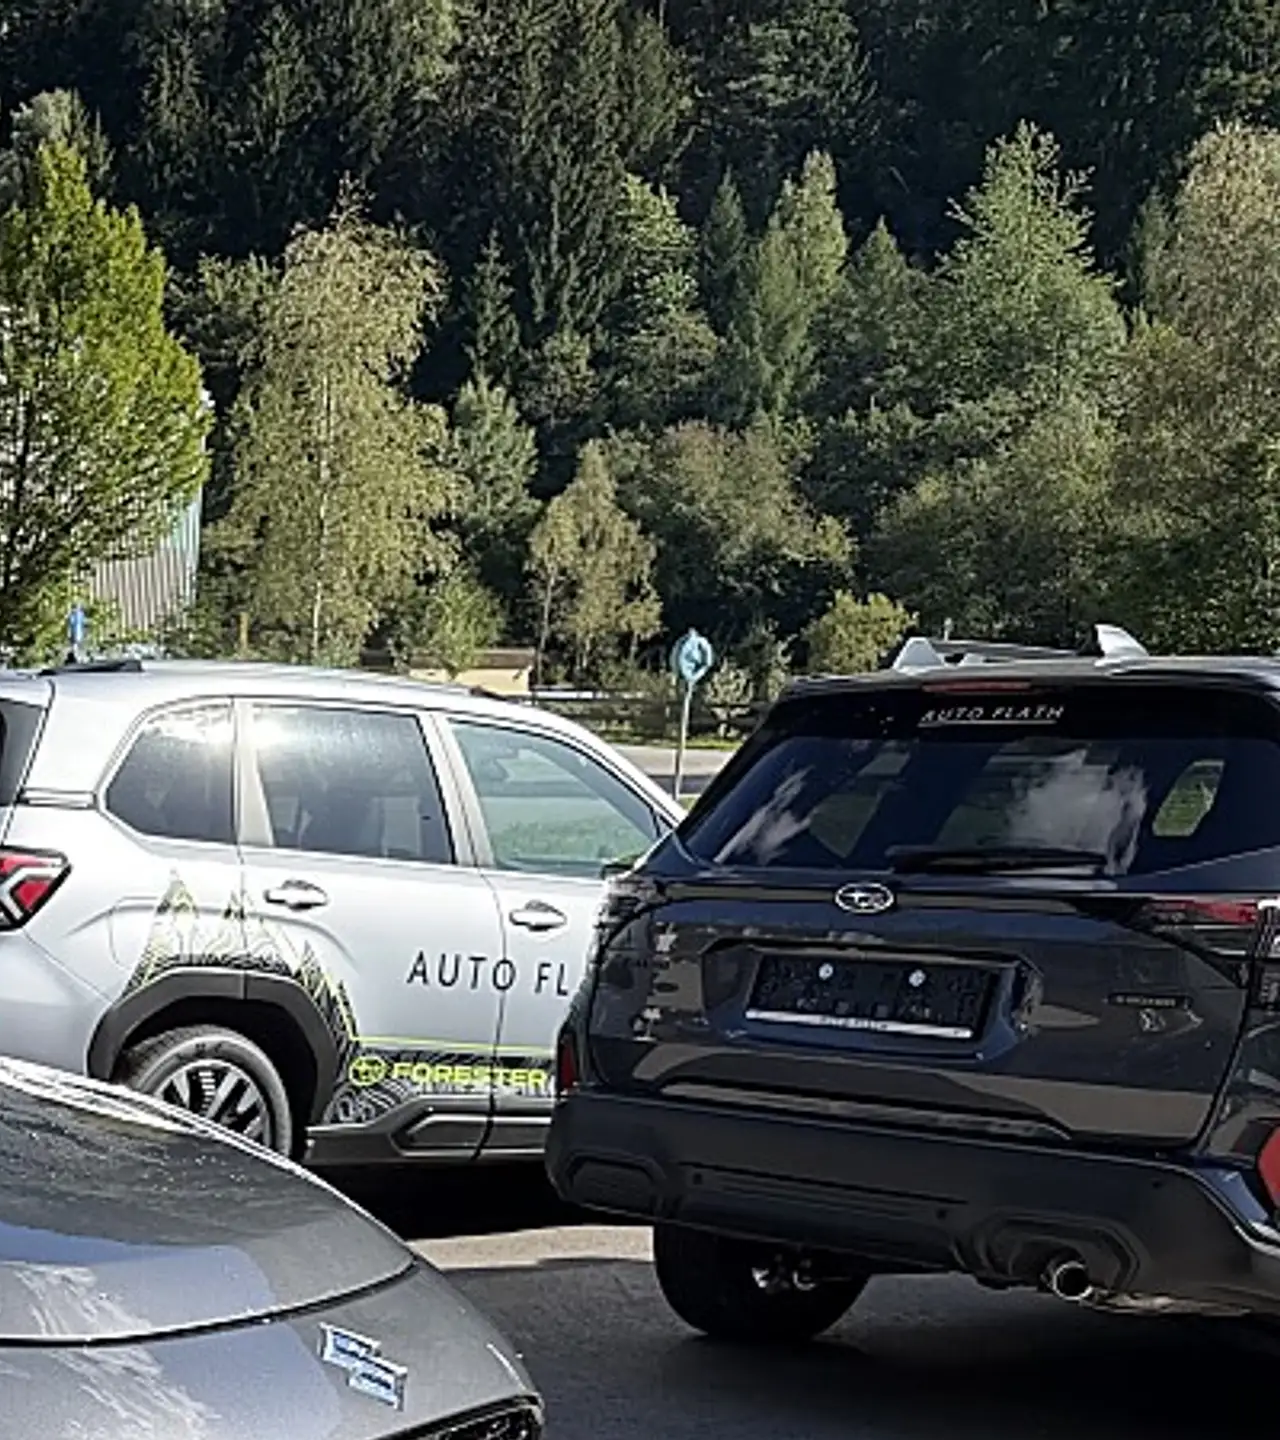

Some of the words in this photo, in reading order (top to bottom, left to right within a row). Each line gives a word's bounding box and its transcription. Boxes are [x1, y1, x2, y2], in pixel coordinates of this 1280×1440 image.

[919, 706, 985, 722] AUTO
[406, 950, 517, 991] AUTO
[392, 1061, 548, 1090] FORESTER
